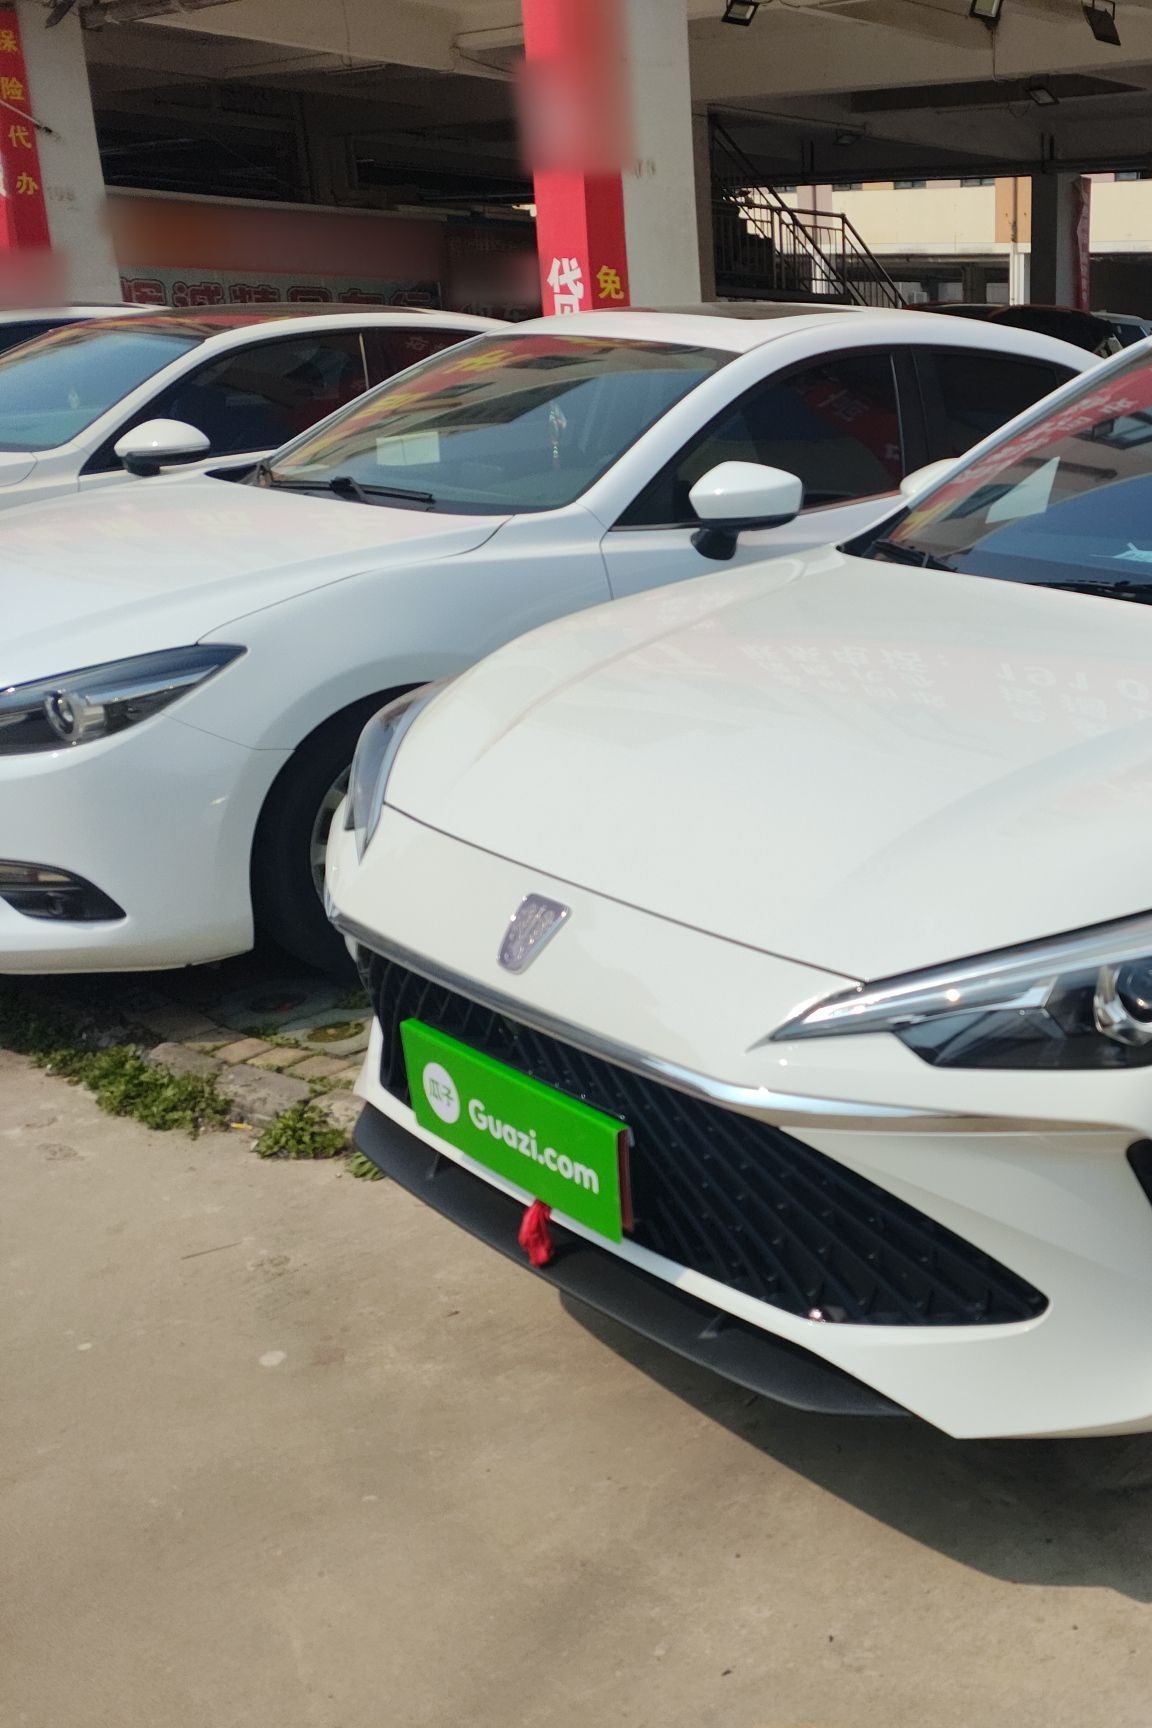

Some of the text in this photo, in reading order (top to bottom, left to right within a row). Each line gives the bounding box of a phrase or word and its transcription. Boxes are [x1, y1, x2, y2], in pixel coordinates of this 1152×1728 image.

[0, 29, 39, 195] 保险代办
[596, 264, 626, 299] 免
[429, 1079, 600, 1195] 瓜子 Guazi.com
